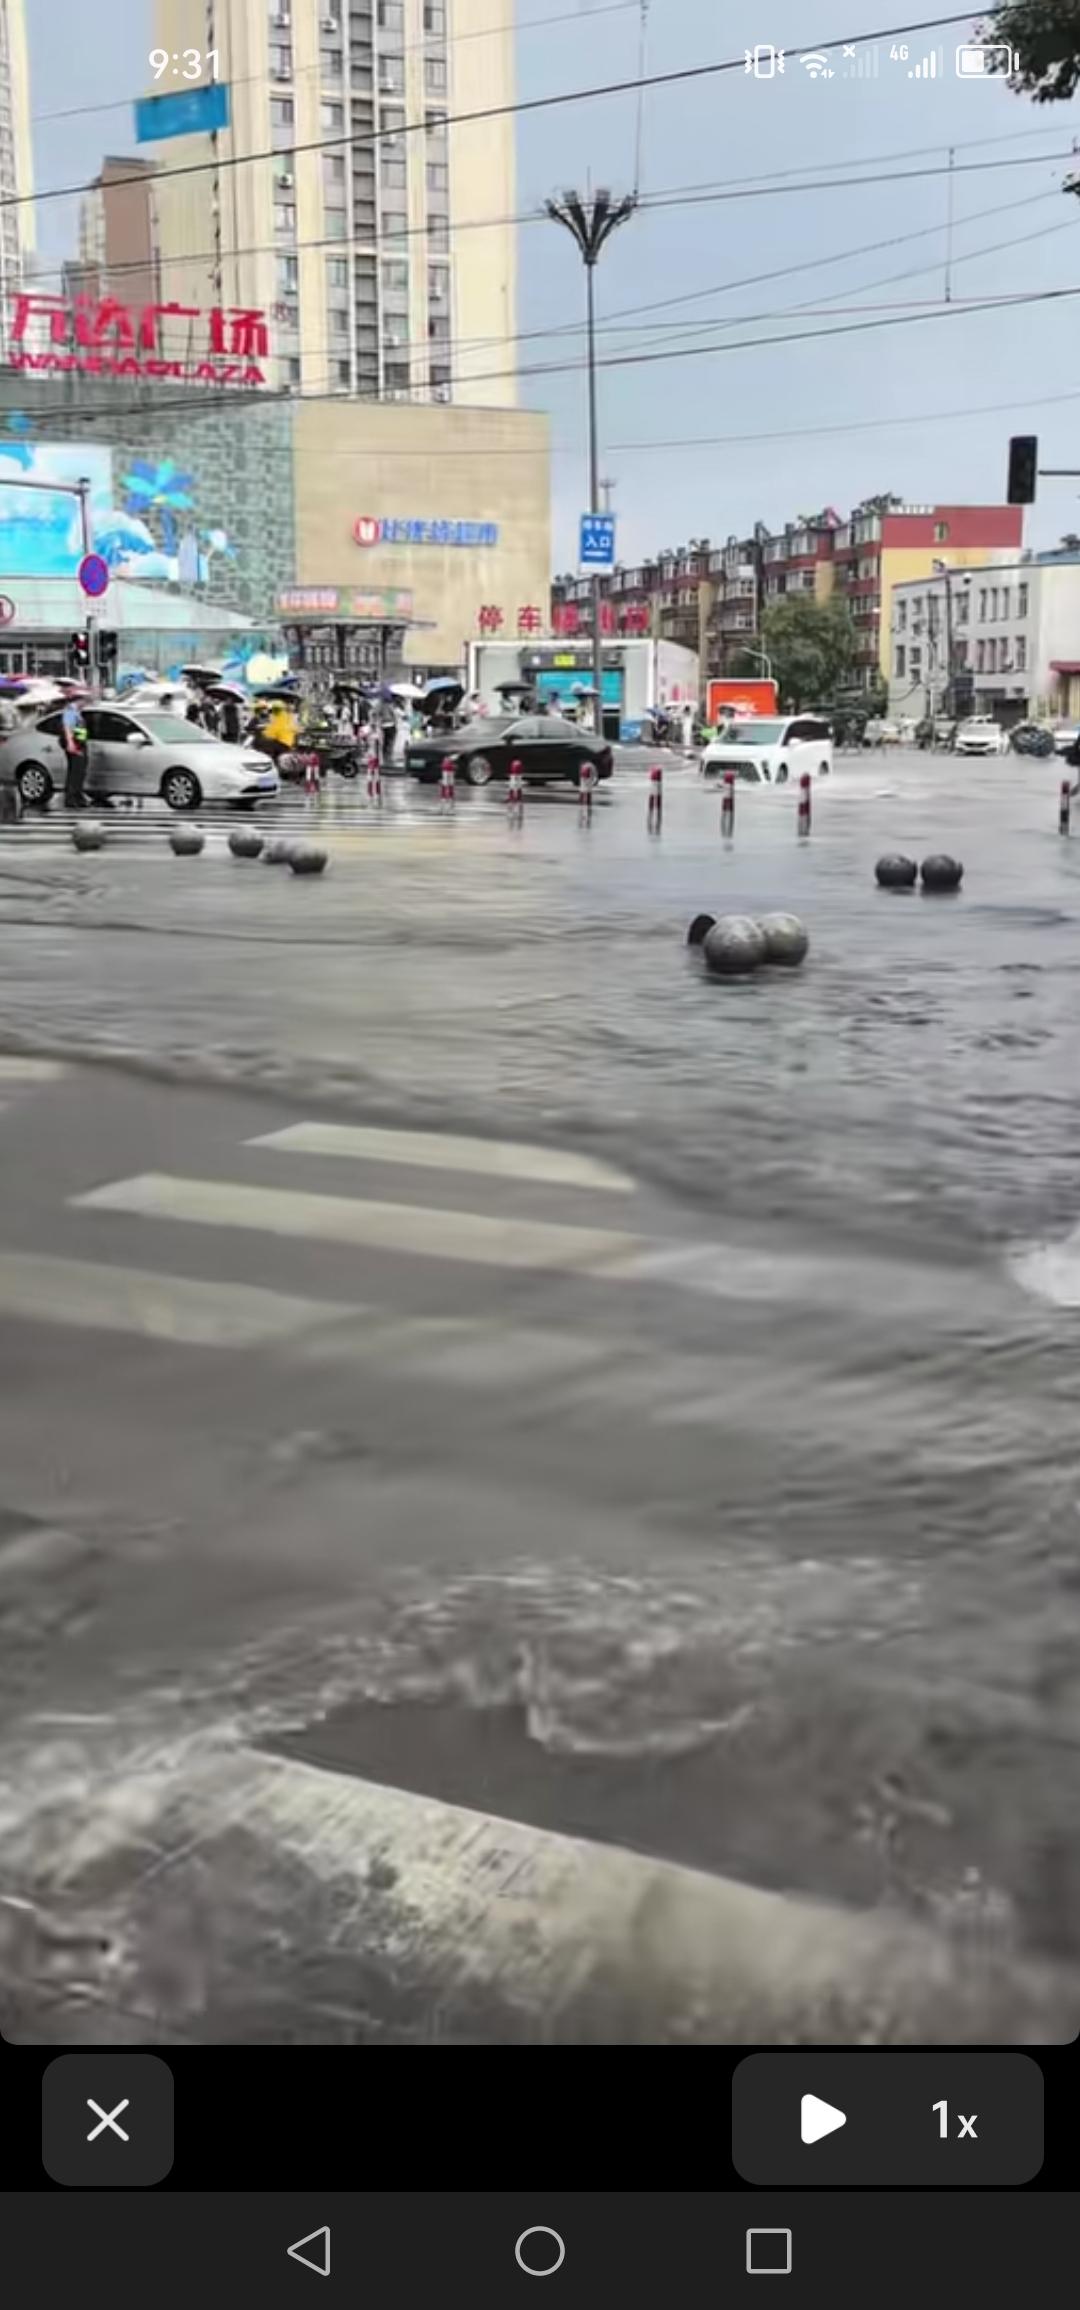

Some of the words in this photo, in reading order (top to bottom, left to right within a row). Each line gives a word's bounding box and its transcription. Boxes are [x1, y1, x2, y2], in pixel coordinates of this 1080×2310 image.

[11, 292, 268, 357] 万达广场
[585, 534, 610, 548] 入口
